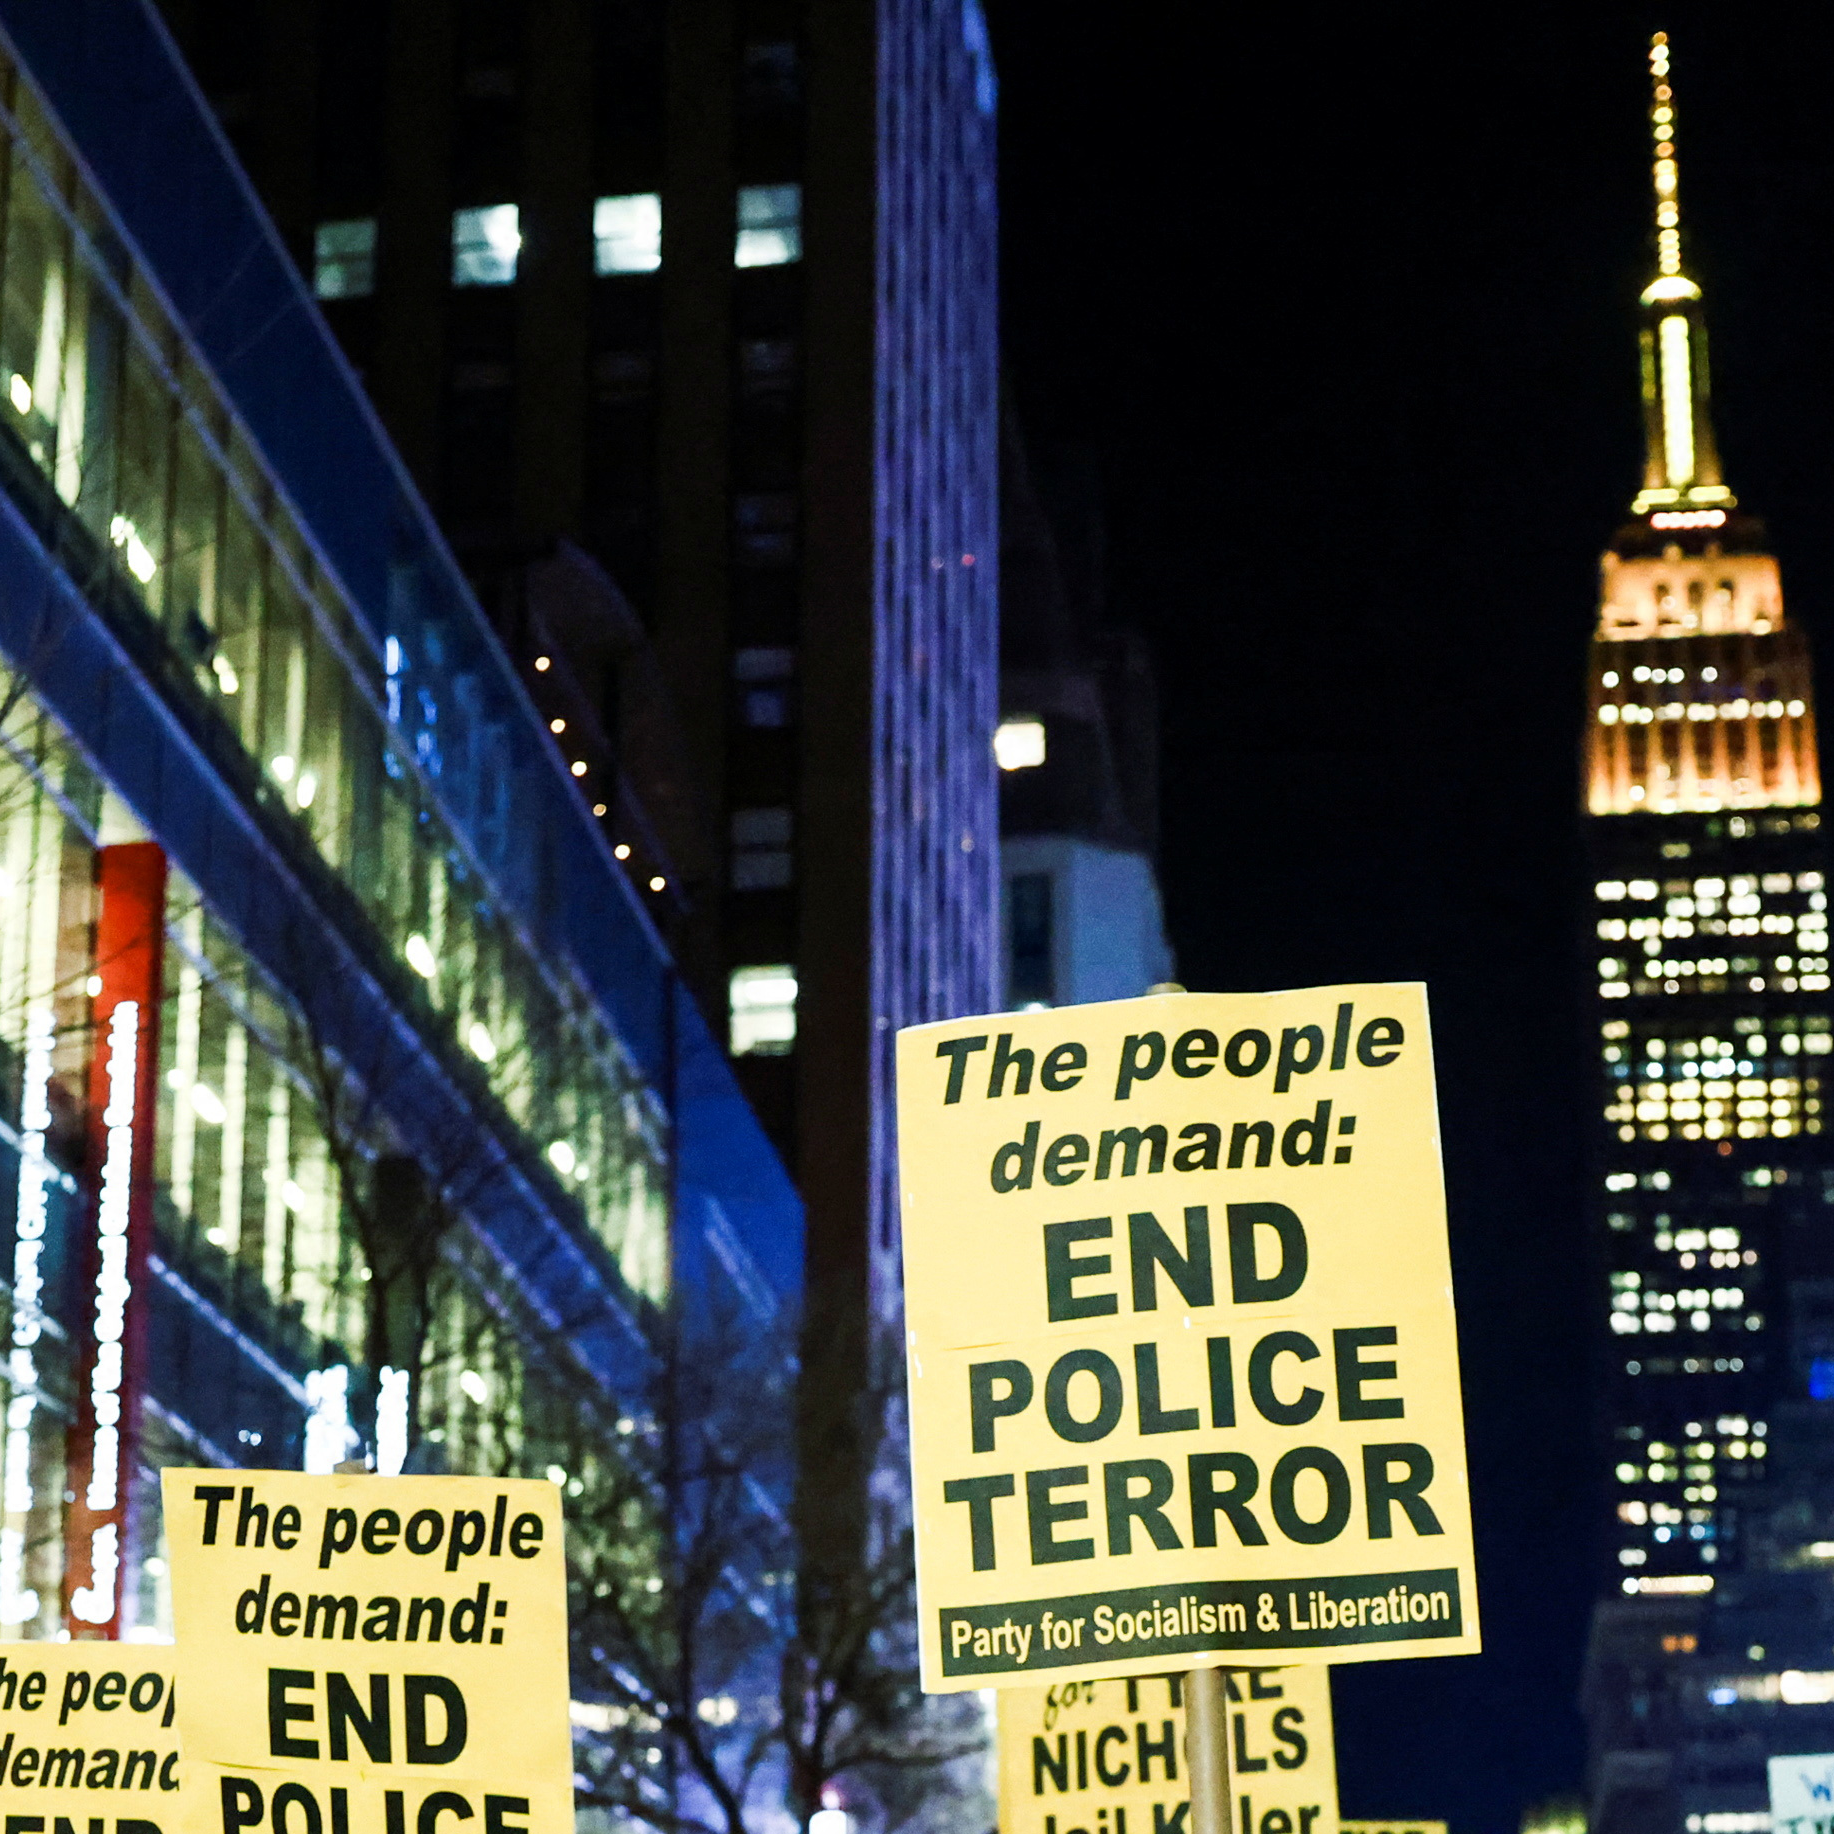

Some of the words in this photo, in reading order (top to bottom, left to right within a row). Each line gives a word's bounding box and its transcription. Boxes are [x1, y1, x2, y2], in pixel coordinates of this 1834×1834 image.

[936, 1033, 1087, 1105] The
[1115, 1003, 1404, 1100] people
[991, 1100, 1356, 1193] demand:
[1044, 1202, 1308, 1322] END
[969, 1326, 1404, 1453] POLICE
[194, 1486, 301, 1550] The
[319, 1495, 543, 1571] people
[944, 1443, 1445, 1571] TERROR
[236, 1574, 507, 1644] demand:
[951, 1618, 1032, 1663] Party
[1041, 1612, 1085, 1650] for
[1094, 1596, 1246, 1644] Socialism
[1257, 1593, 1280, 1631] &
[1289, 1585, 1449, 1630] Liberation
[268, 1668, 467, 1765] END
[1032, 1707, 1308, 1796] NICHLS
